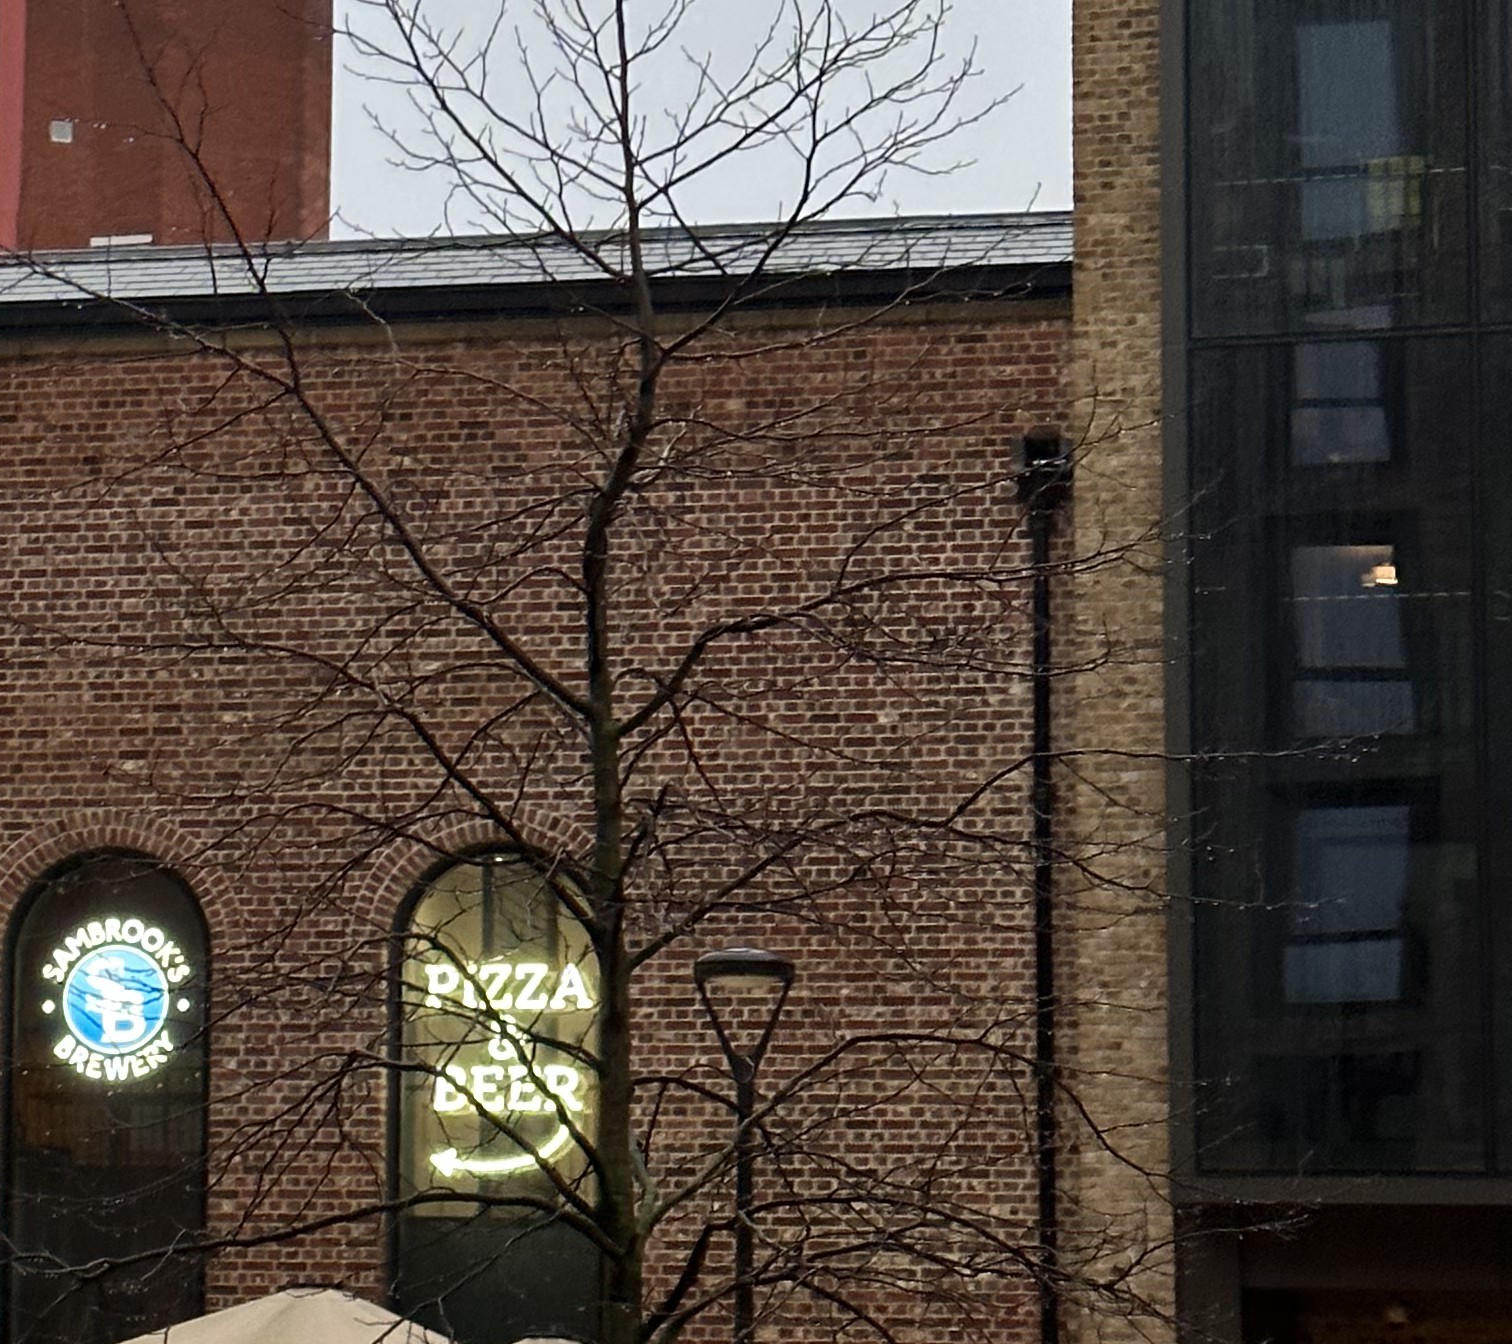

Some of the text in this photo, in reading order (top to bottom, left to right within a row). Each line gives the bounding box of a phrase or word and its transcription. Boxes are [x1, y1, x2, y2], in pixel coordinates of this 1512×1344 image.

[42, 918, 190, 983] SAMBROOK'S
[424, 963, 593, 1010] PIZZA
[53, 1030, 174, 1081] BREWERY
[433, 1065, 583, 1111] BEER
